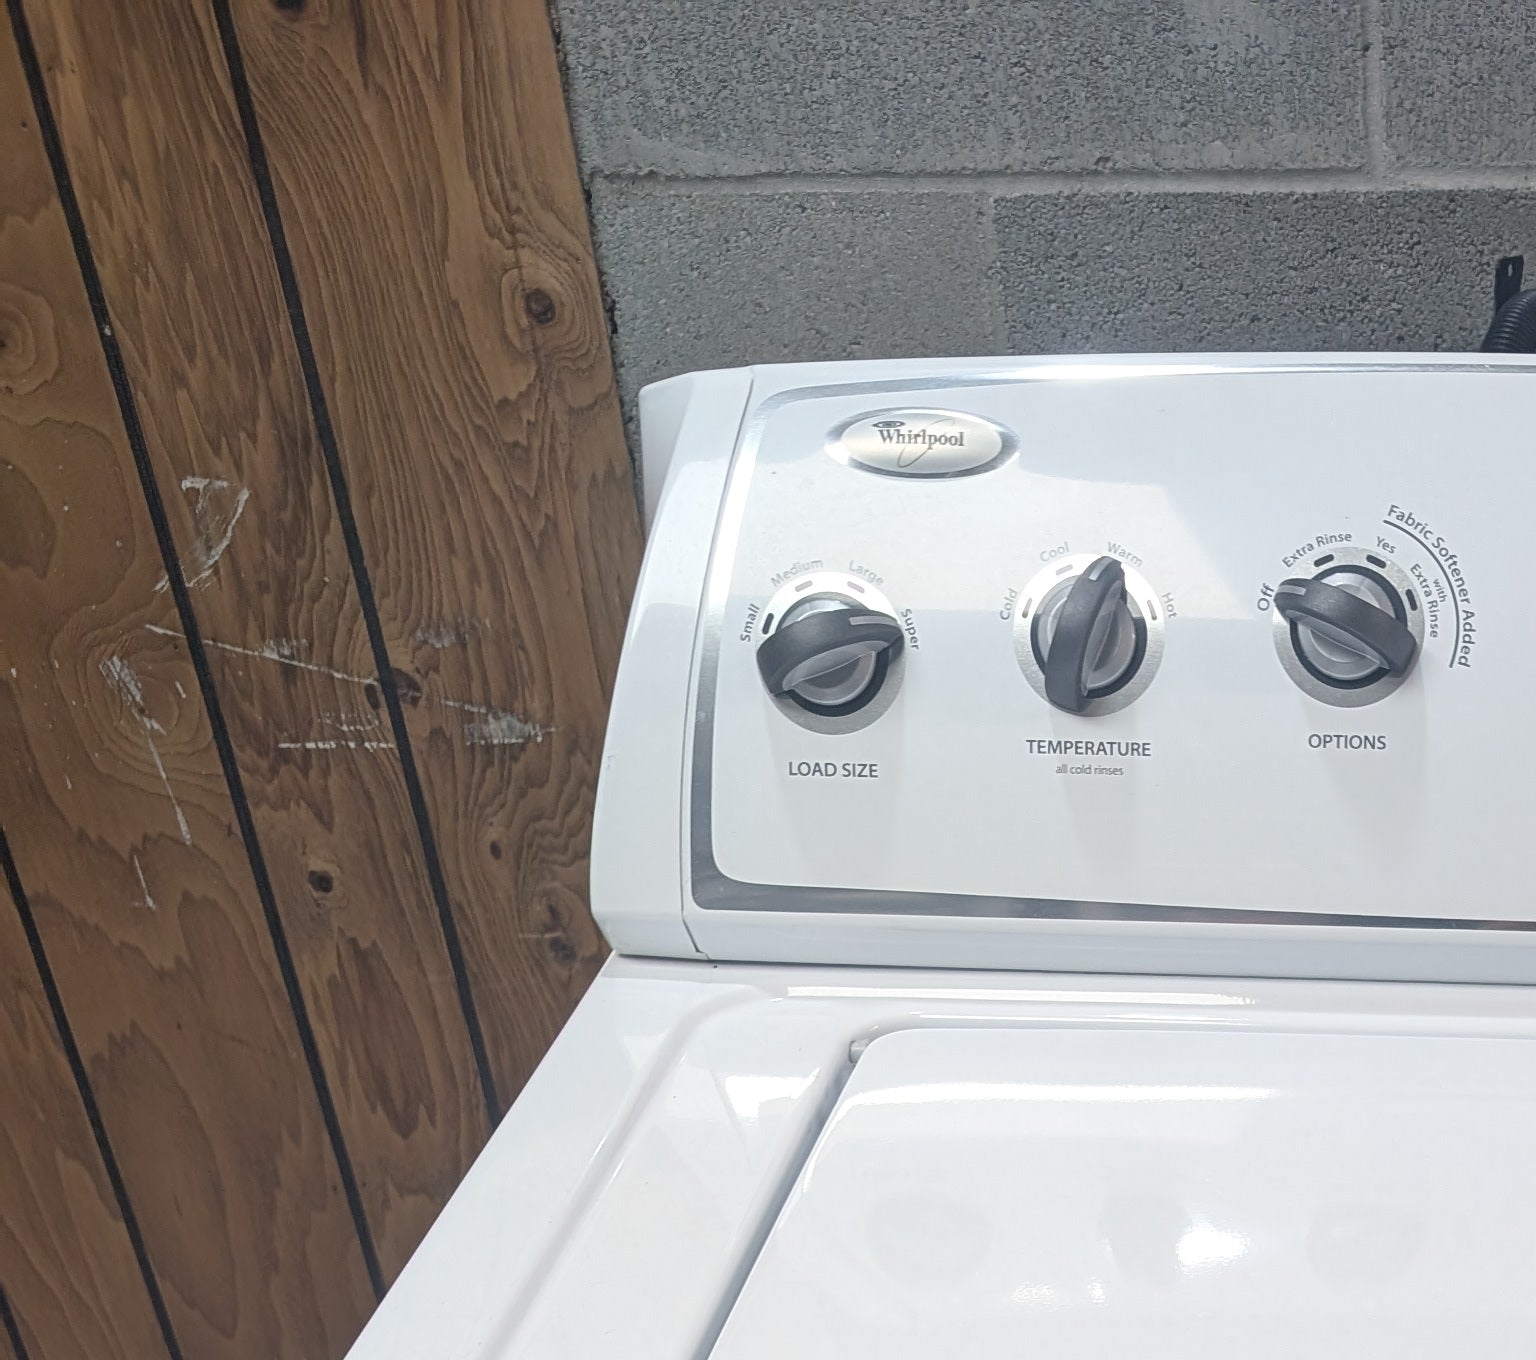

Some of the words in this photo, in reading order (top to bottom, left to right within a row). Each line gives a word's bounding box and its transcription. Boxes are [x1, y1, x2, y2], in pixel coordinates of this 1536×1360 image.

[878, 428, 965, 450] Whirlpool
[1040, 541, 1070, 562] Cool
[1107, 541, 1144, 568] Warm
[1282, 542, 1315, 568] Extra
[1315, 533, 1352, 548] Rinse
[1376, 536, 1397, 555] Yes
[770, 559, 825, 587] Medium
[848, 560, 885, 586] Large
[1387, 504, 1433, 541] Fabric
[1431, 537, 1471, 605] Softener
[1457, 609, 1477, 668] Added
[1000, 588, 1018, 620] Cold
[1257, 582, 1275, 612] Off
[1410, 563, 1433, 599] Extra
[1428, 600, 1439, 638] Rinse
[1433, 578, 1447, 603] with
[1162, 591, 1177, 619] Hot
[740, 603, 761, 642] Small
[900, 608, 920, 650] Super
[1026, 739, 1151, 756] TEMPERATURE
[1308, 734, 1386, 750] OPTIONS
[788, 762, 837, 777] LOAD
[842, 763, 879, 778] SIZE
[1055, 764, 1067, 774] all
[1069, 764, 1092, 775] cold
[1094, 765, 1124, 776] rinses
